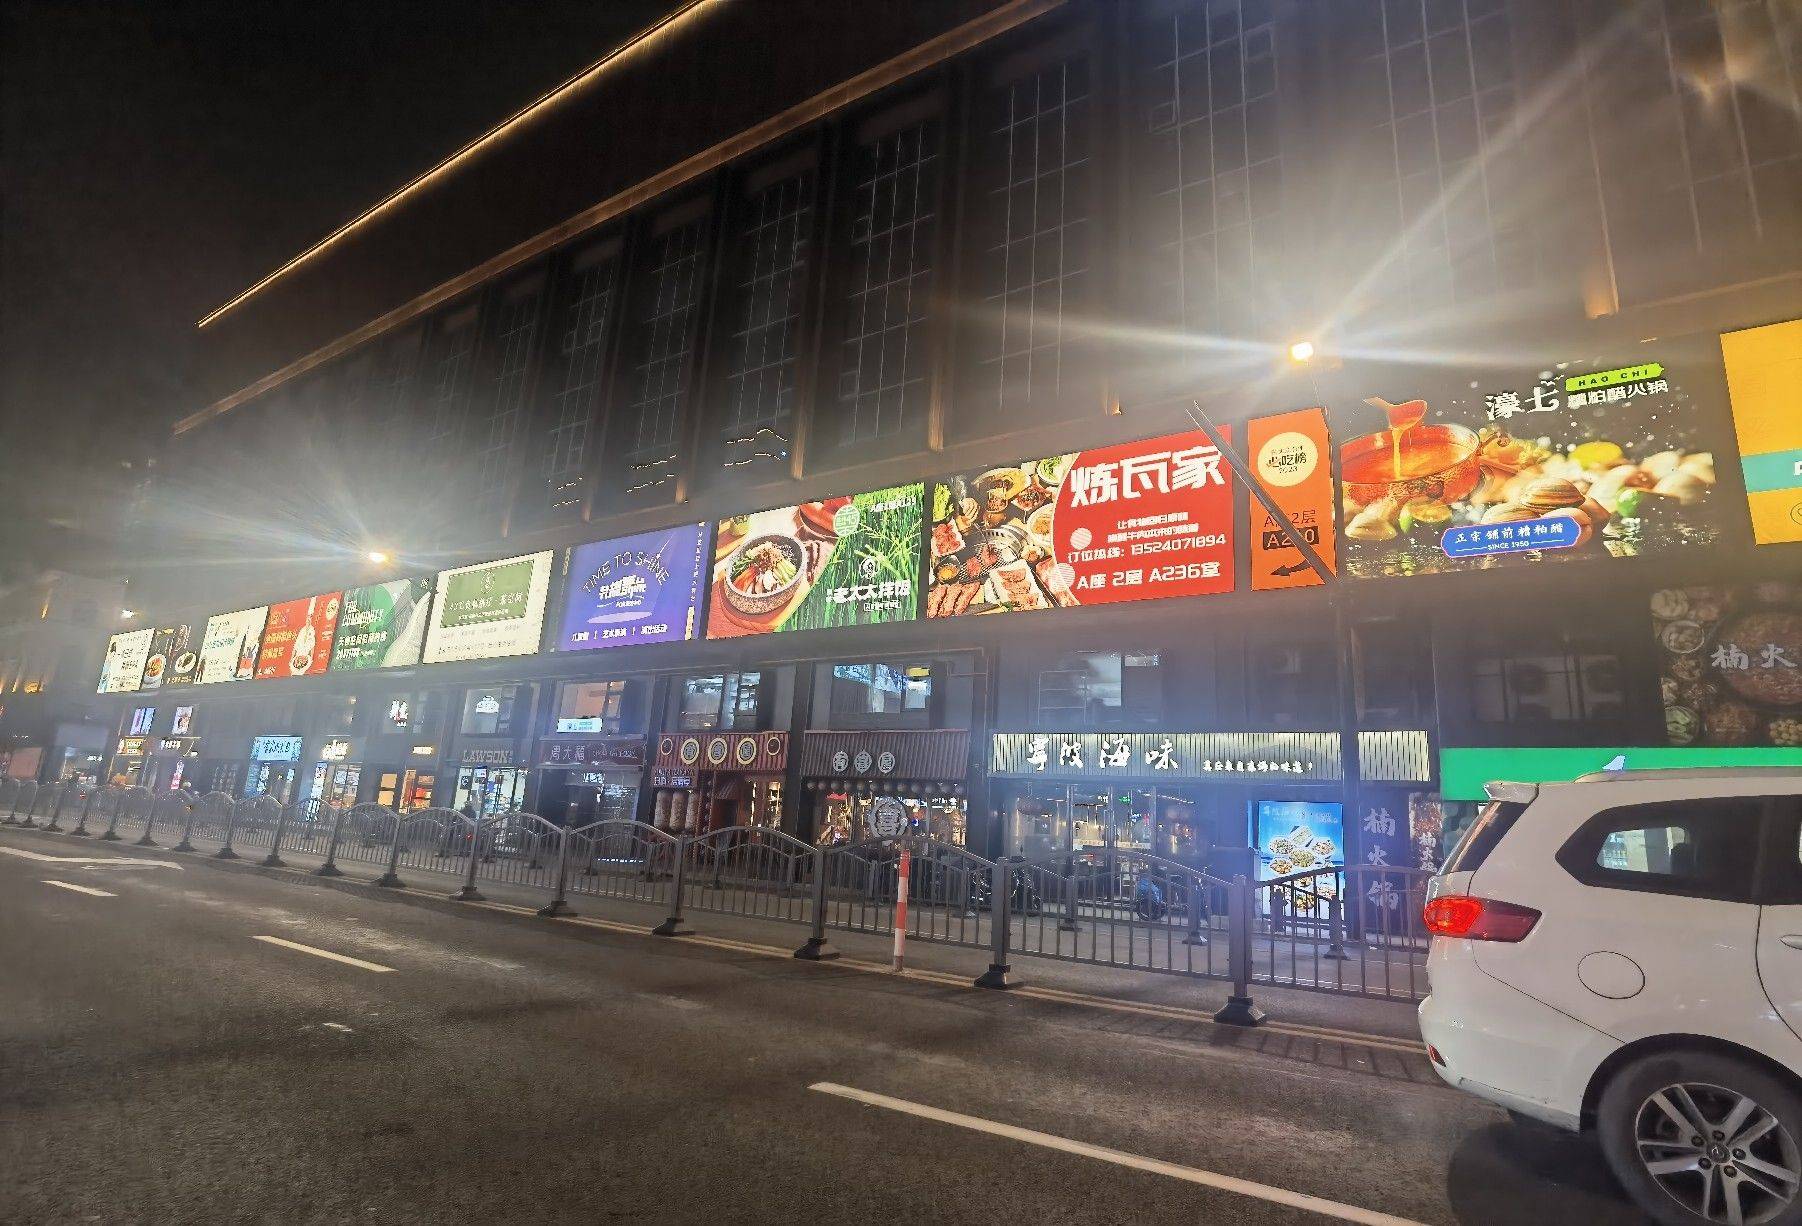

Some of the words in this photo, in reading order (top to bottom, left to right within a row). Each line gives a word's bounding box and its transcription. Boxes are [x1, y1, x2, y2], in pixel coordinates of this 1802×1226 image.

[1578, 374, 1609, 388] HAO
[1620, 369, 1649, 380] CHI
[1266, 452, 1307, 467] 必吃榜
[1131, 533, 1227, 556] 13524071894
[1265, 529, 1315, 549] A20
[1487, 542, 1510, 551] SINCE
[583, 560, 612, 593] TIME
[614, 551, 633, 568] TO
[1076, 573, 1107, 590] A座
[1112, 568, 1143, 587] 2层
[1149, 561, 1221, 583] A236室
[461, 749, 510, 763] LAWSON
